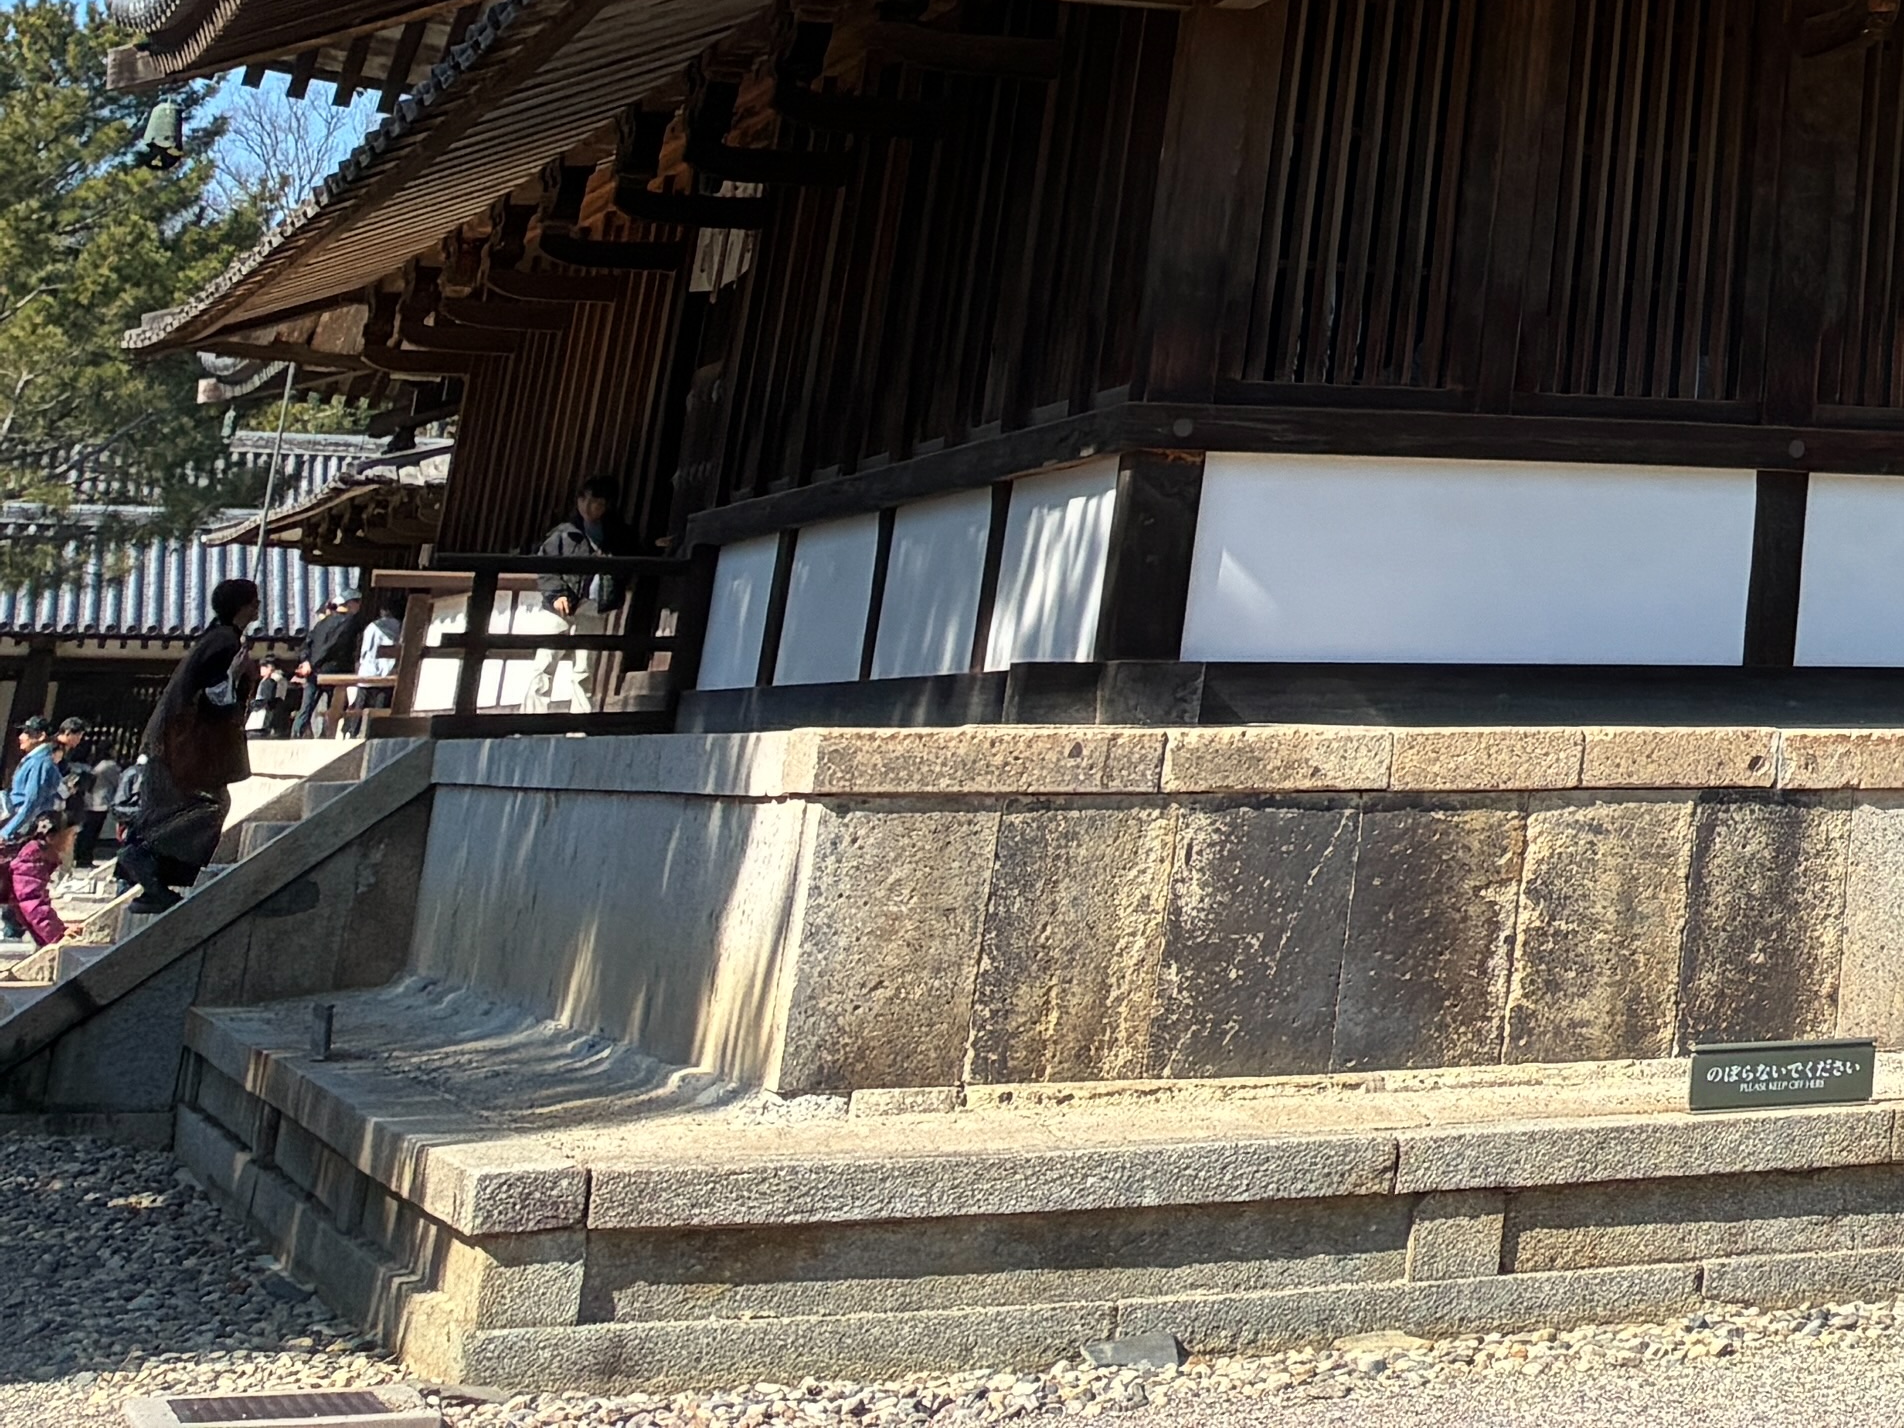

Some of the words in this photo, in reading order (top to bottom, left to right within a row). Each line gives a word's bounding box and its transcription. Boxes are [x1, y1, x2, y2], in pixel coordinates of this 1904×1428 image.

[1706, 1059, 1861, 1082] のぼらないでください
